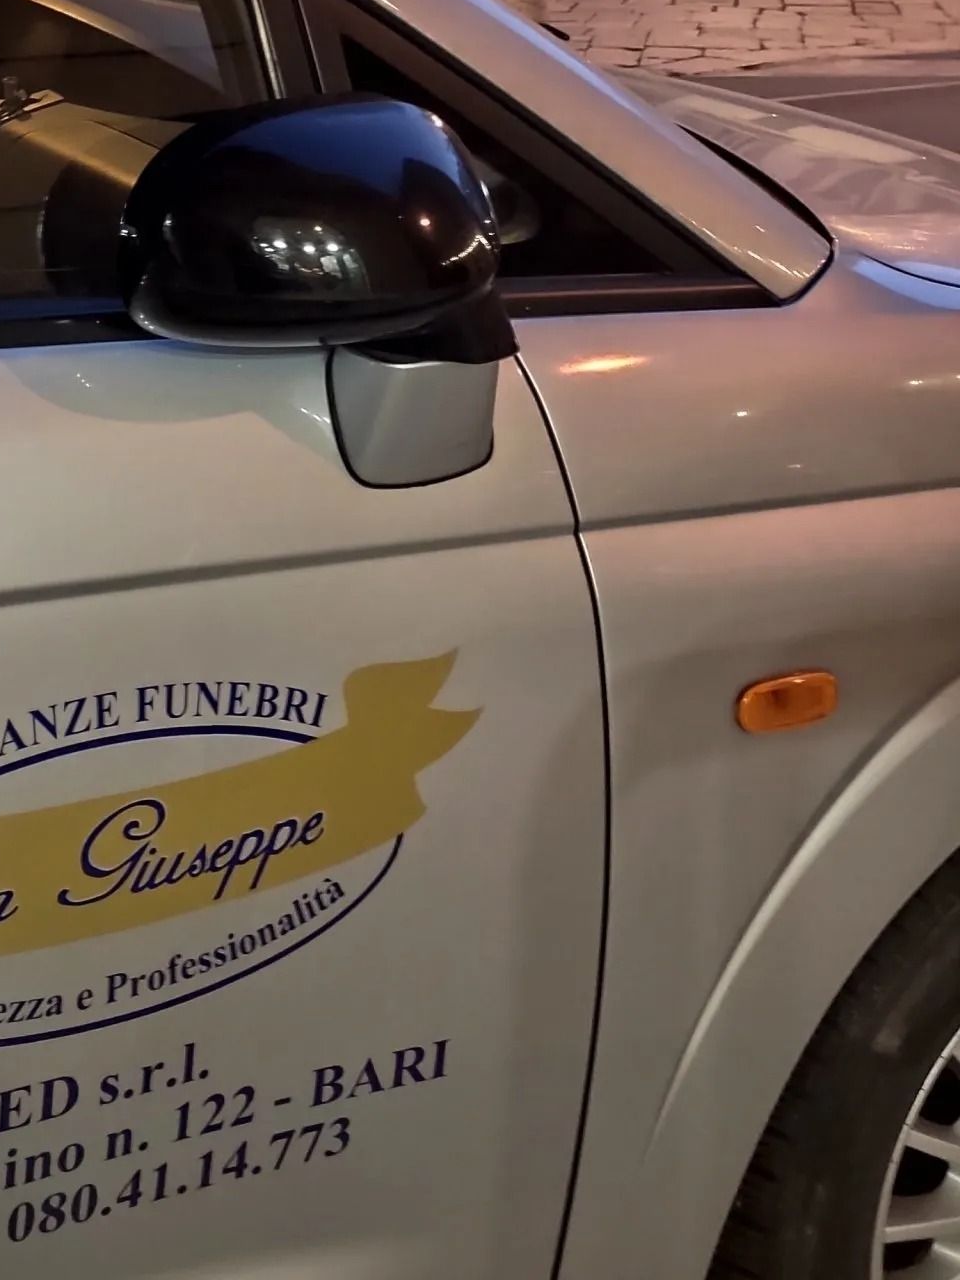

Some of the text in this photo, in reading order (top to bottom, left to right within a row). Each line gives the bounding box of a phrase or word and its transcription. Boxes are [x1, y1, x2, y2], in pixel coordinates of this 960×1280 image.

[136, 681, 329, 728] FUNEBRI
[57, 799, 326, 908] Giuseppe
[76, 988, 94, 1011] e
[105, 877, 345, 1005] Professionalità
[99, 1042, 209, 1107] s.r.l.
[105, 1128, 149, 1161] n.
[175, 1085, 256, 1143] 122
[310, 1039, 449, 1108] BARI
[7, 1117, 351, 1244] 080.41.14.773
